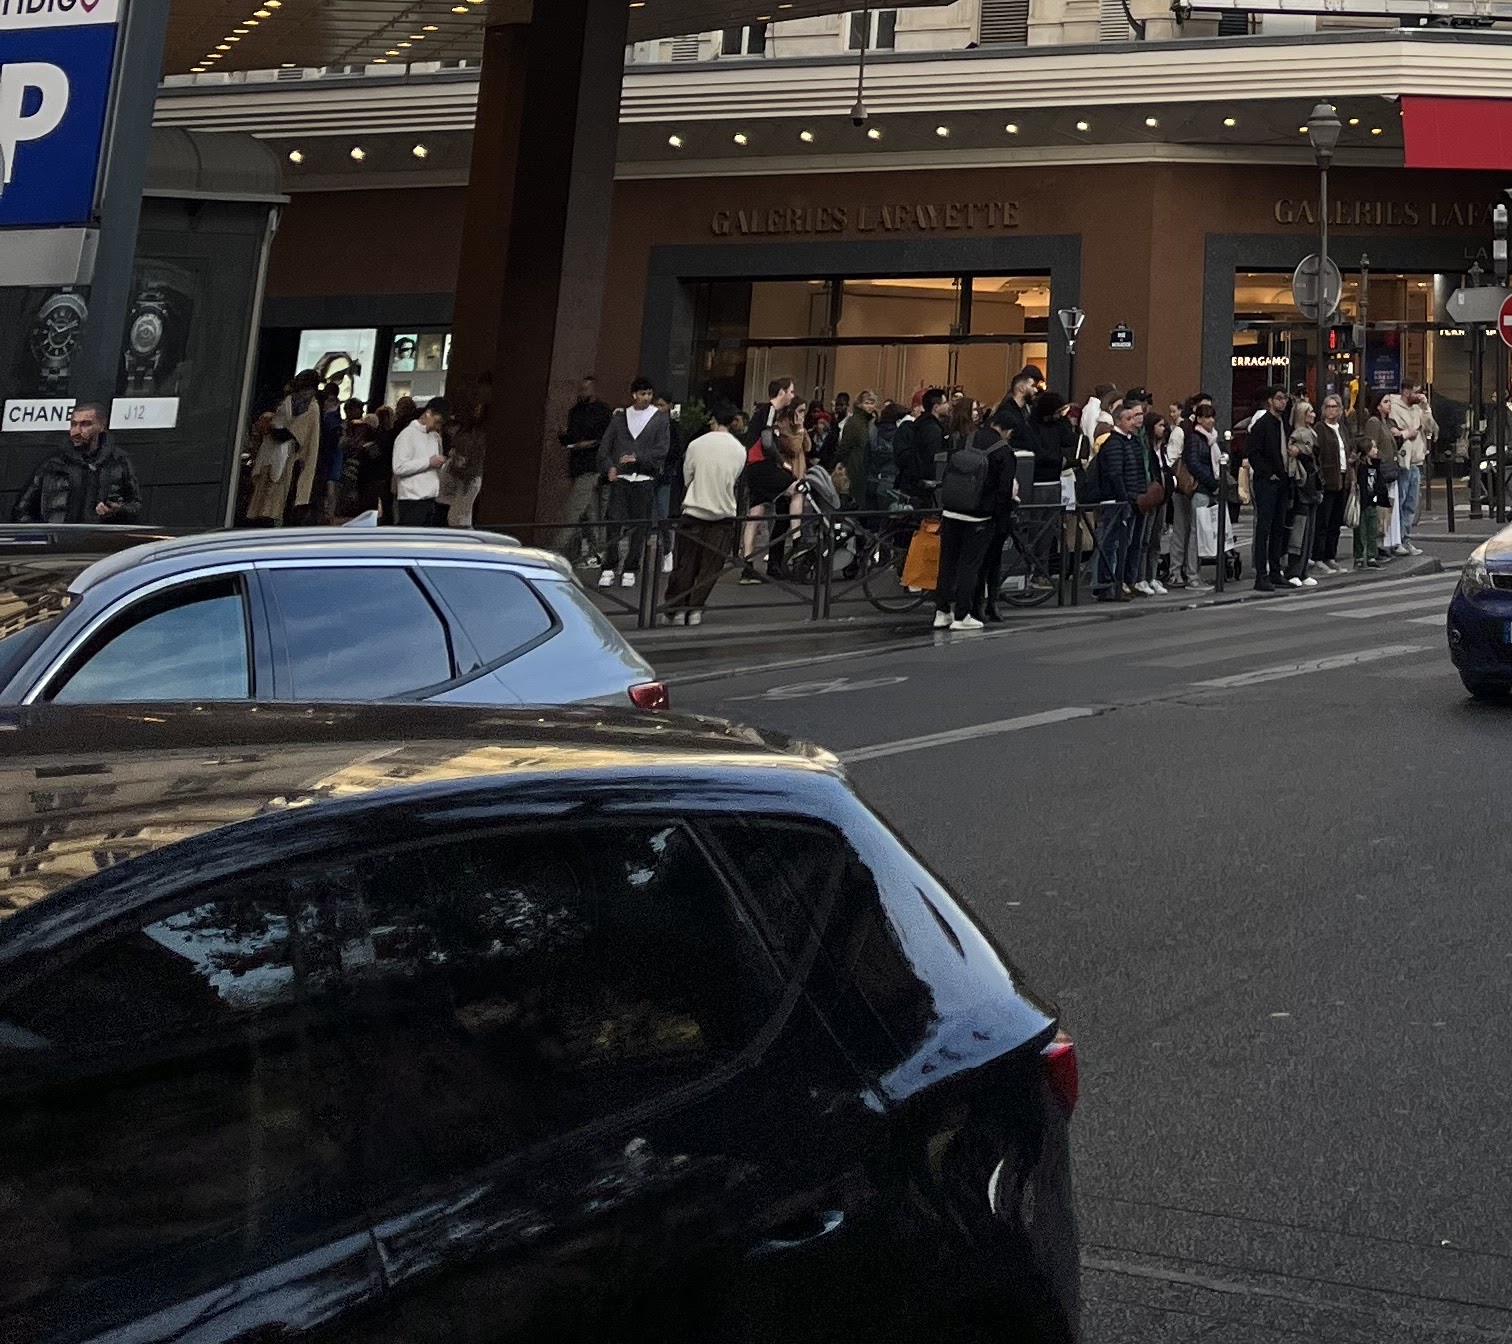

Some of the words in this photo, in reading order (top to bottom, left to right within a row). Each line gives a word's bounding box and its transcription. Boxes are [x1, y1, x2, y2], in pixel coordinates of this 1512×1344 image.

[0, 62, 70, 183] P
[711, 207, 848, 236] GALERIES
[856, 200, 1021, 232] LAFAYETTE
[1231, 356, 1290, 367] ERRAGAMO
[9, 405, 76, 423] CHANE
[124, 404, 146, 421] J12
